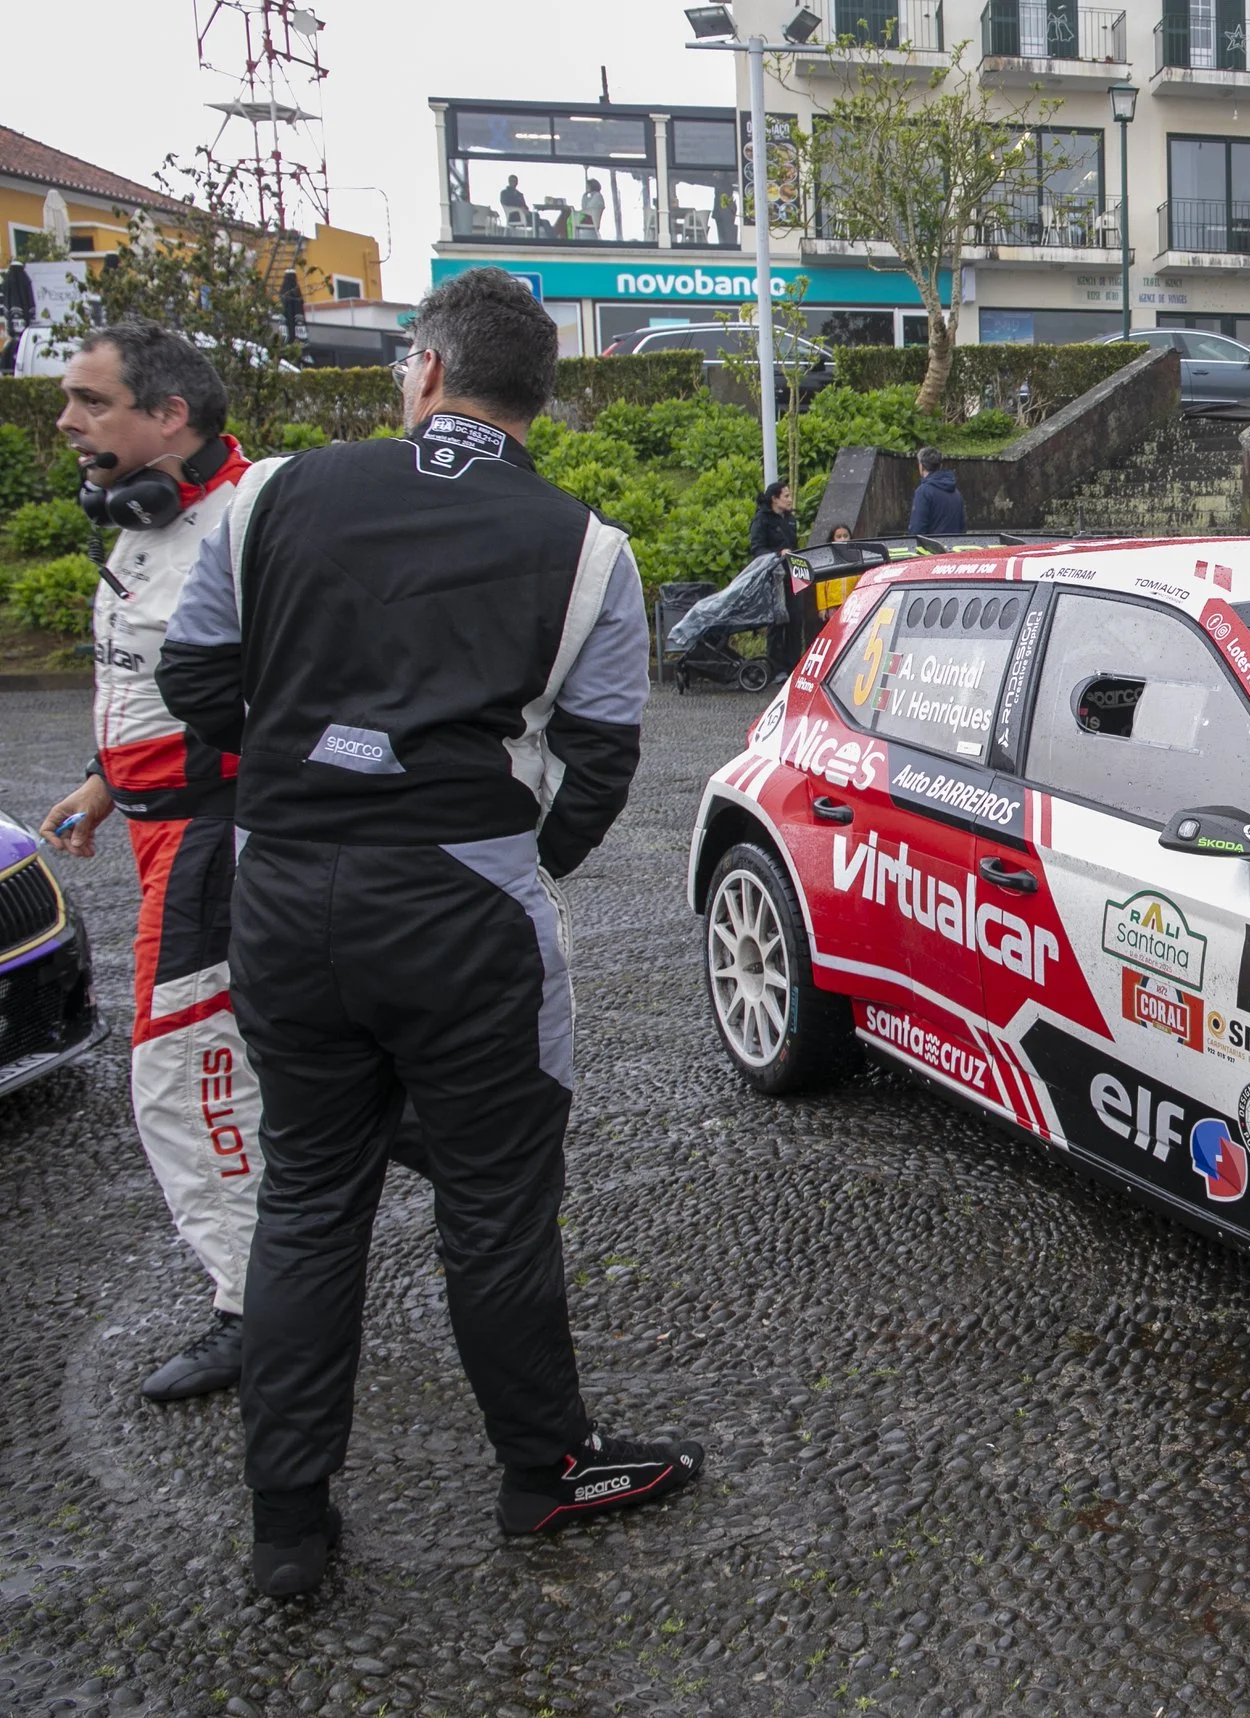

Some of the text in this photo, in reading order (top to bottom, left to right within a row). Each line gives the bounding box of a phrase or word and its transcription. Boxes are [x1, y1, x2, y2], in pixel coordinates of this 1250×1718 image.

[433, 420, 452, 431] FIA
[1057, 567, 1097, 581] RETIRAM
[1134, 578, 1191, 601] TOMIAUTO
[853, 607, 896, 706] 5
[898, 653, 985, 689] A. Quintal
[1013, 610, 1044, 704] creative graphics
[889, 687, 993, 733] V. Henriques
[326, 736, 383, 759] sparco
[892, 763, 1021, 825] Auto BARREIROS
[833, 830, 1060, 987] virtualcar
[1130, 902, 1180, 940] RALI
[1116, 922, 1190, 969] Santana
[1140, 993, 1185, 1032] CORAL
[866, 1005, 987, 1090] santa cruz
[202, 1047, 251, 1178] LOTES
[1089, 1072, 1186, 1163] elf
[574, 1474, 632, 1501] sparco
